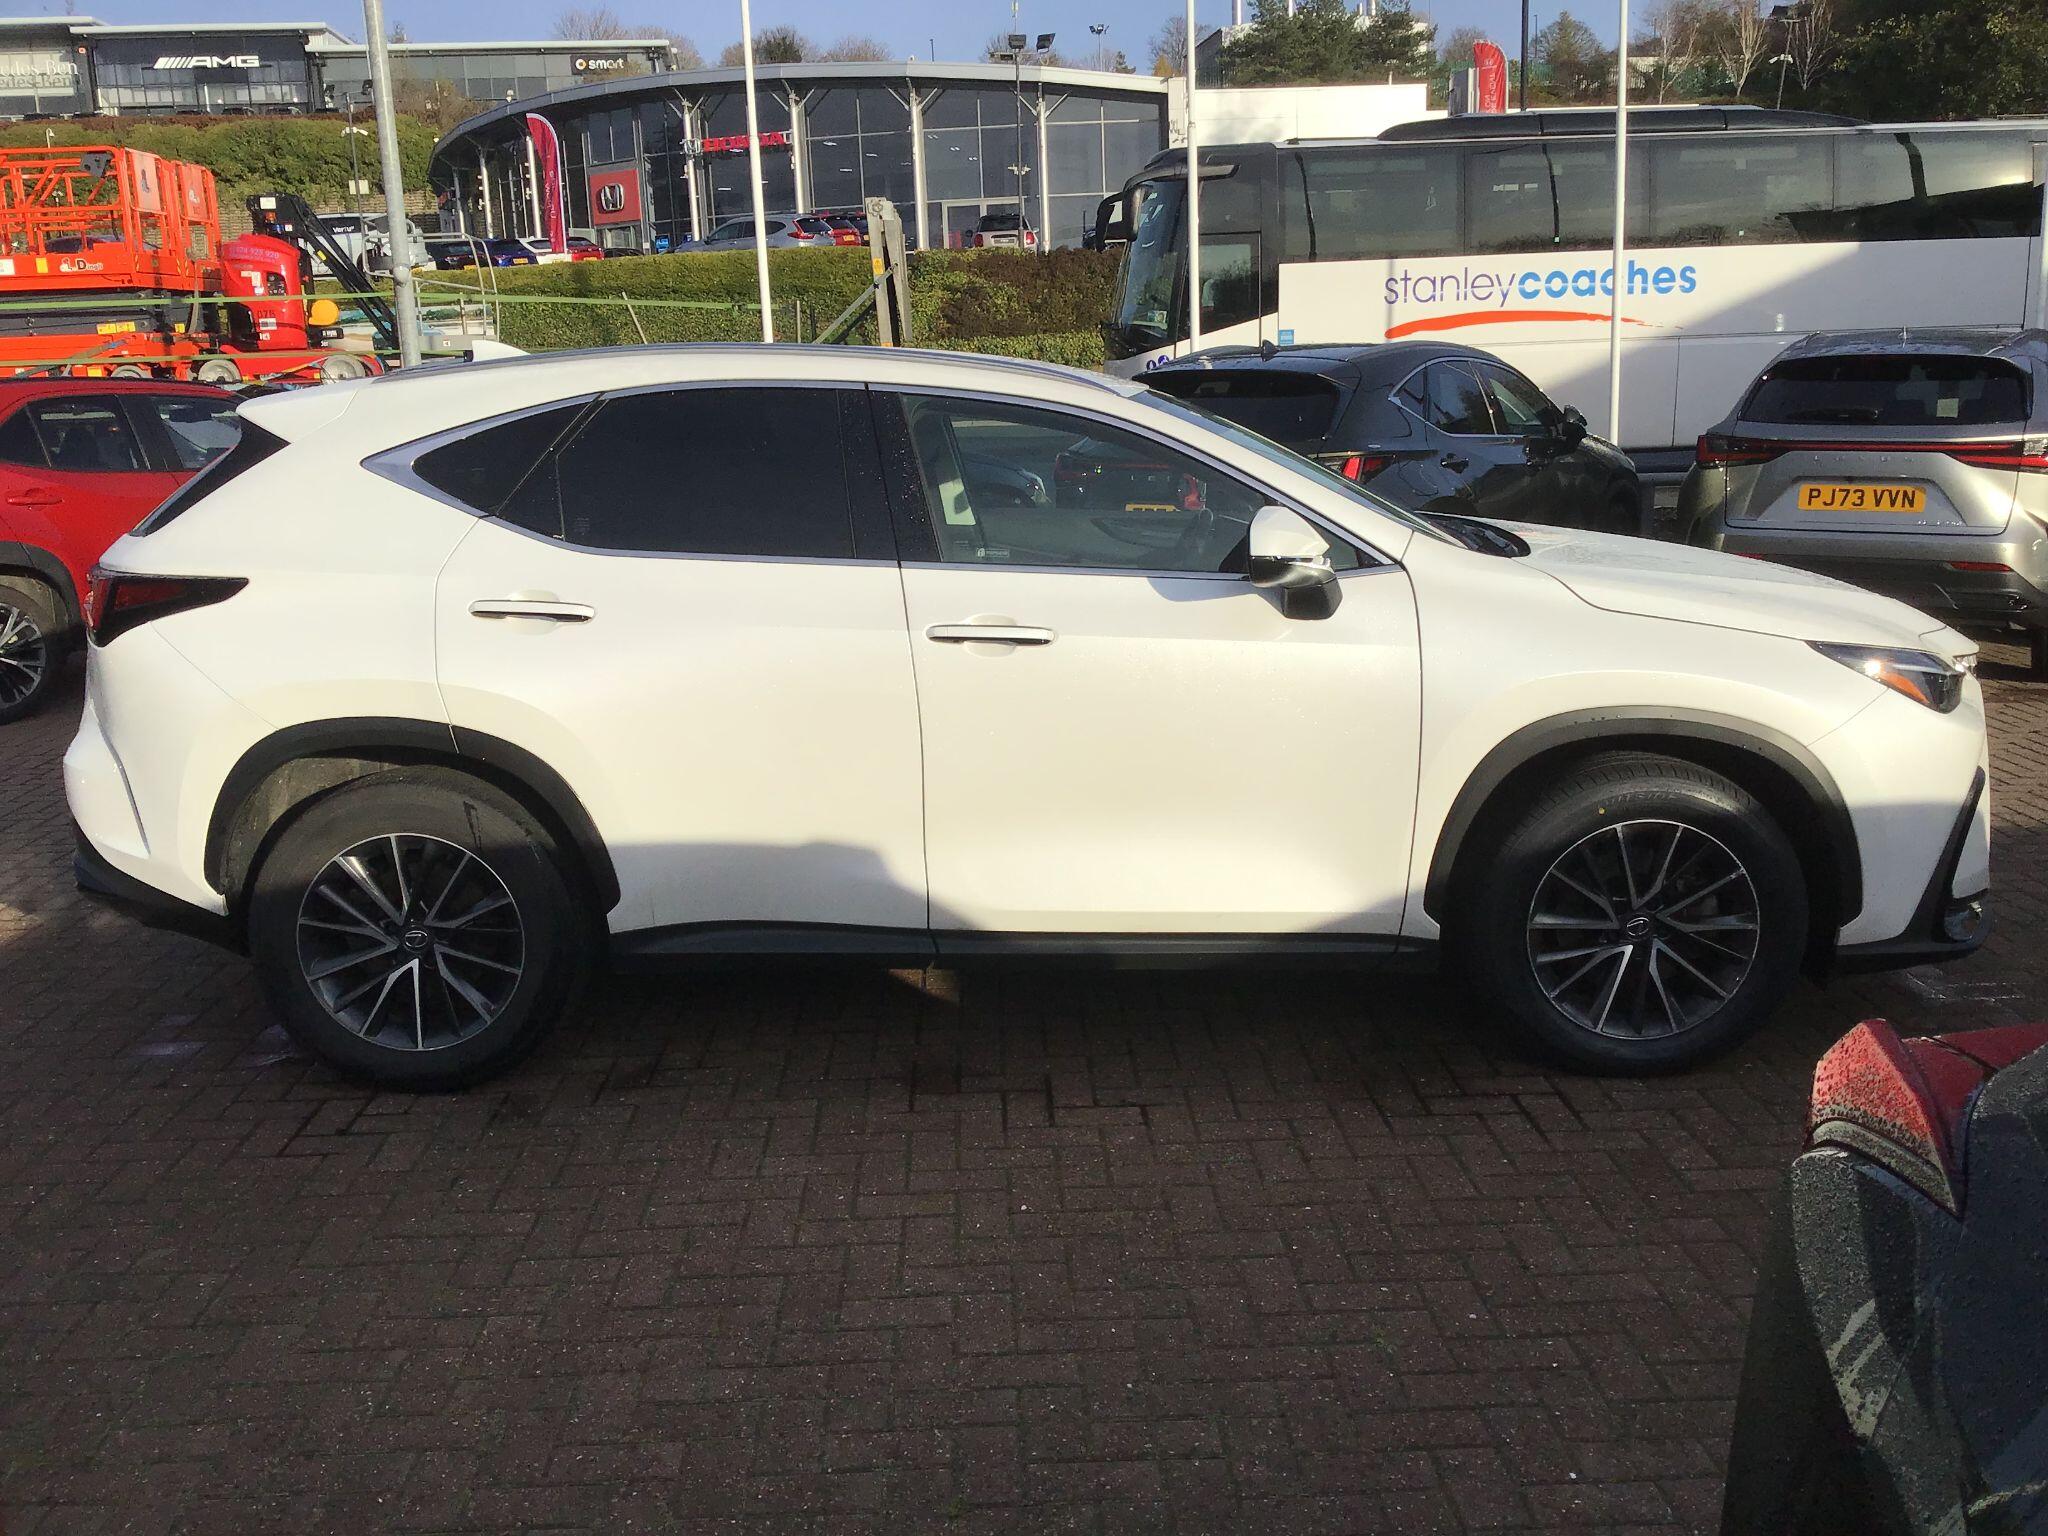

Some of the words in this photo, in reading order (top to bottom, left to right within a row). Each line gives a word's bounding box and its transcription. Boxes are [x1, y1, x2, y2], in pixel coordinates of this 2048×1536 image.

[186, 56, 259, 68] AMG
[588, 58, 624, 69] smart
[1807, 488, 1865, 506] PJ73
[1873, 489, 1915, 508] VVN
